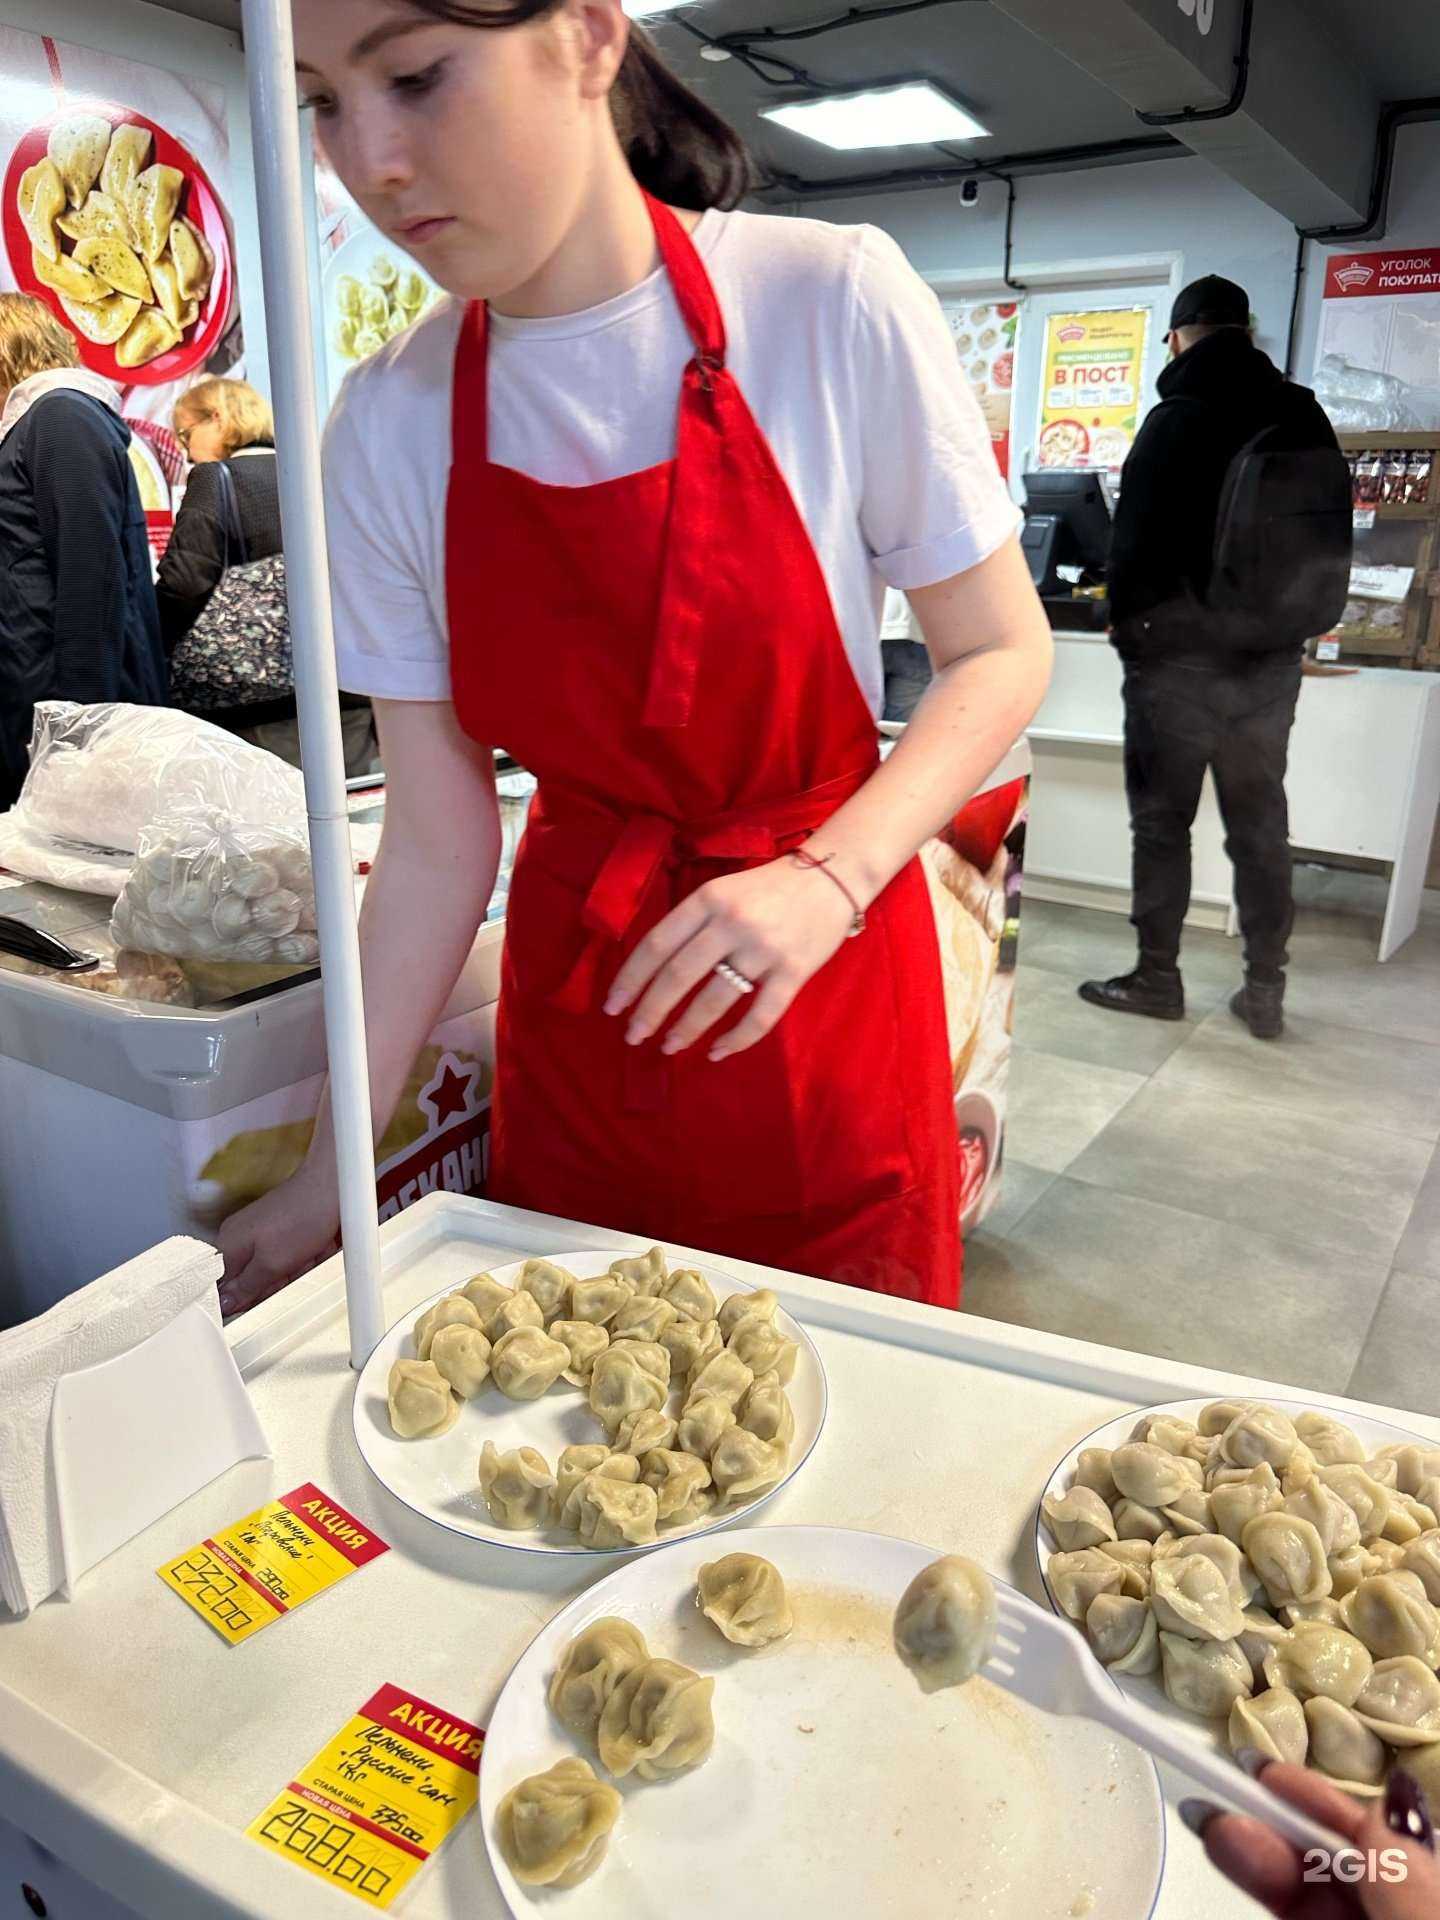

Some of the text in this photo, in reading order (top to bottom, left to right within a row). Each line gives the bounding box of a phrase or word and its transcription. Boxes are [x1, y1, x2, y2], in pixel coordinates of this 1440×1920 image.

[1381, 258, 1431, 272] УГОЛОК
[1055, 365, 1131, 384] В ПОСТ
[270, 1511, 314, 1546] Пельмени
[302, 1499, 368, 1549] АКЦИЯ
[212, 1546, 243, 1574] НОВАЯ ЦЕНА
[224, 1541, 241, 1556] СТАРАЯ
[240, 1553, 256, 1568] ЦЕНА
[388, 1702, 484, 1760] АКЦИЯ
[355, 1725, 434, 1770] Пельмени
[302, 1789, 352, 1820] НОВАЯ ЦЕНА
[313, 1778, 343, 1797] СТАРАЯ
[343, 1794, 365, 1809] ЦЕНА
[260, 1801, 392, 1897] 268.00
